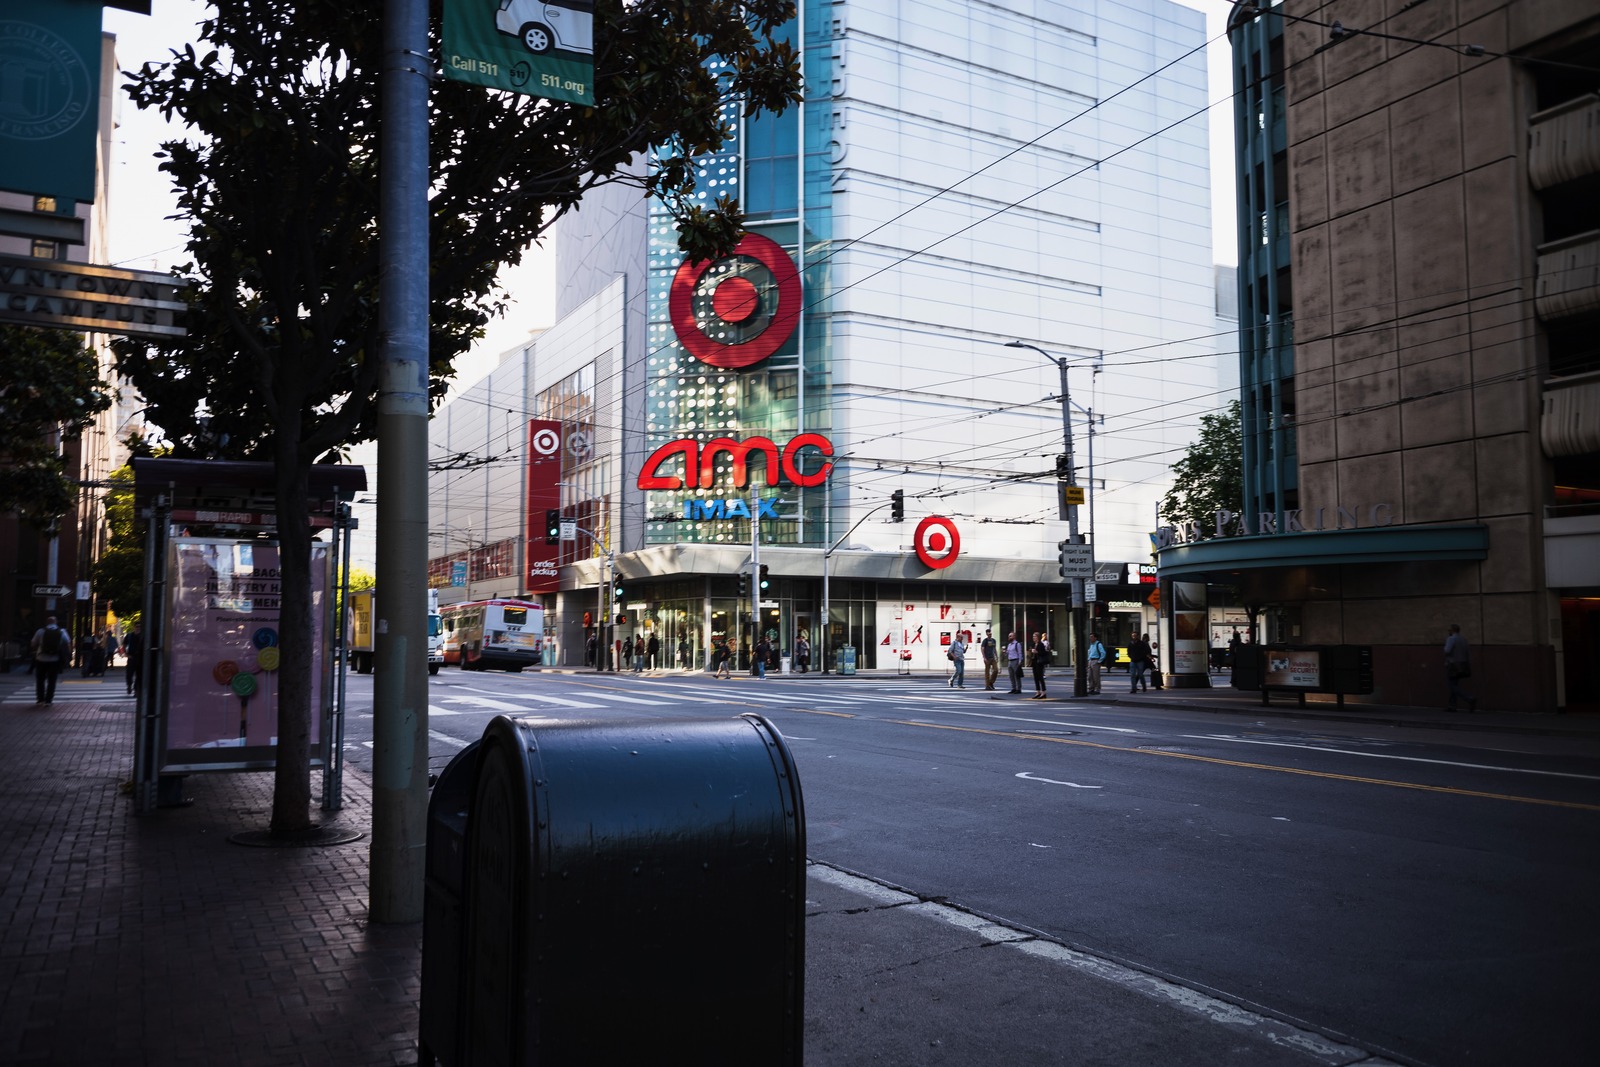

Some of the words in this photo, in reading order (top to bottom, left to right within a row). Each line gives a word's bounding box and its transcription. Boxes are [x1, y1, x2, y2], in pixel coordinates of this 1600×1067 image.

[451, 55, 476, 72] Call
[478, 61, 498, 77] 511
[509, 69, 526, 79] 511
[541, 73, 585, 96] 511.org
[820, 0, 847, 196] ETREON
[7, 293, 157, 325] CAMPUS
[219, 511, 252, 525] RAPID
[682, 497, 780, 520] IMAX
[1214, 503, 1394, 538] PARKING
[531, 568, 558, 577] pickup
[534, 560, 556, 568] order
